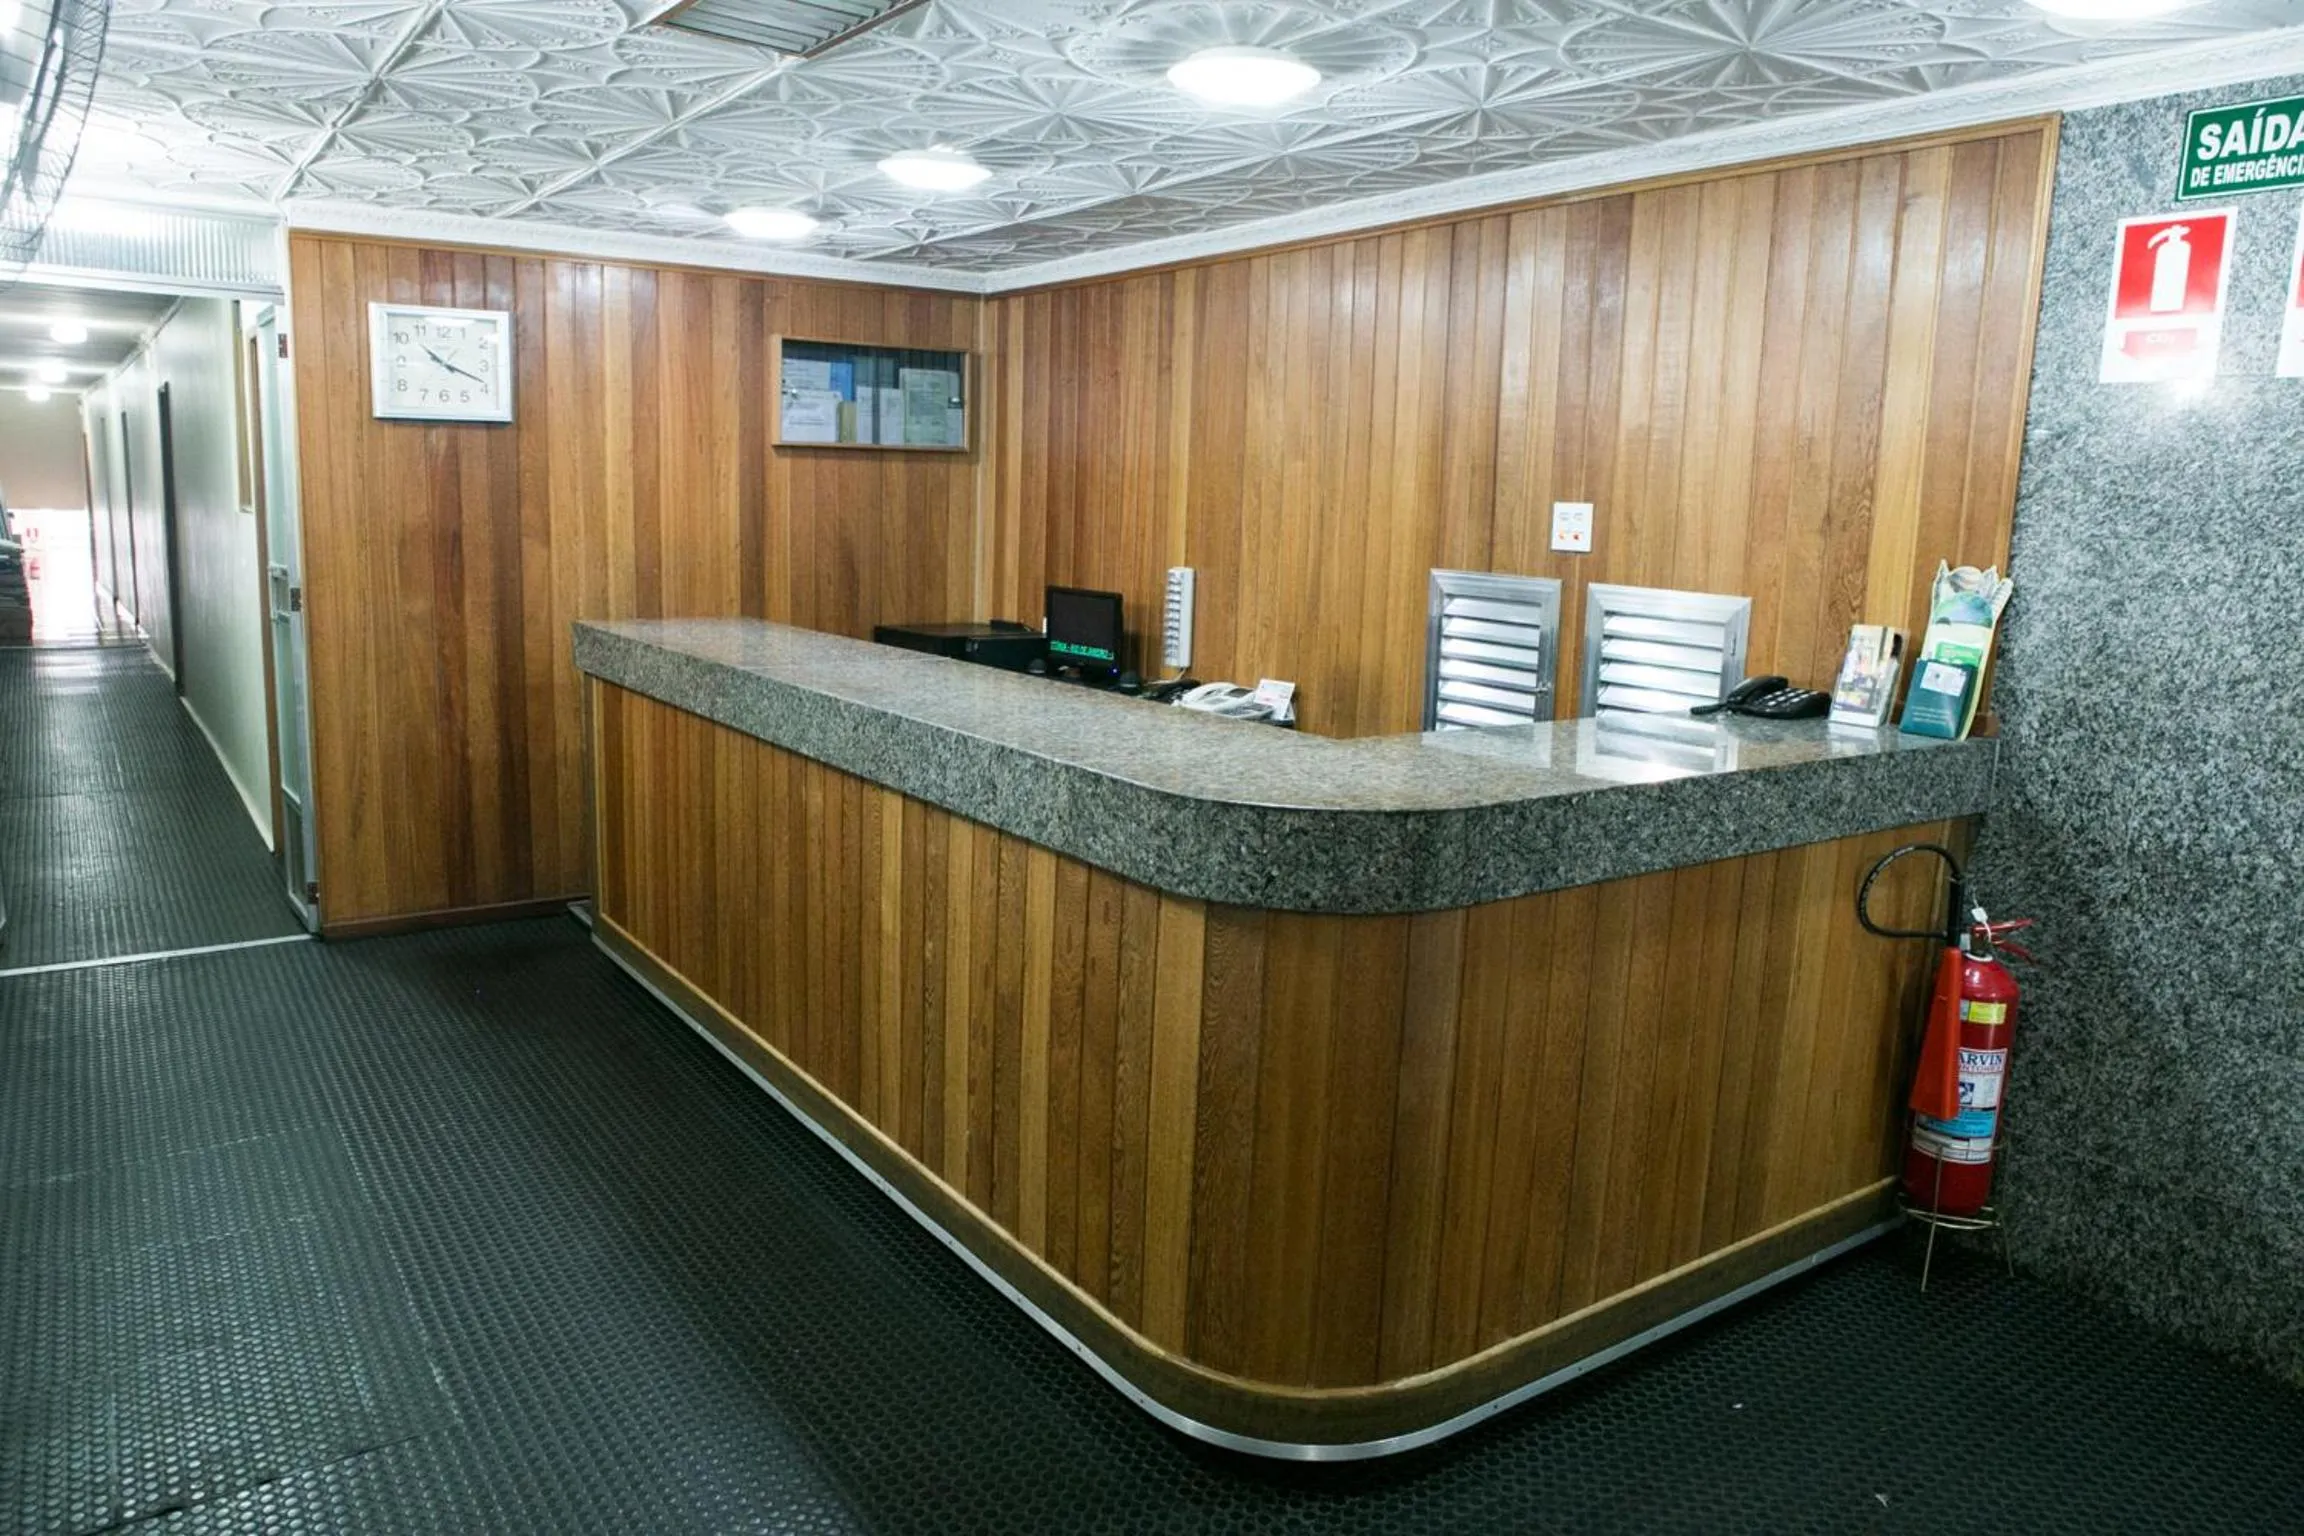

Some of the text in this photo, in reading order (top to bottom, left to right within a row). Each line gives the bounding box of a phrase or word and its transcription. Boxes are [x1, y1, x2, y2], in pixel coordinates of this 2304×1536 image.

[2197, 107, 2304, 160] SAÍDA
[2190, 153, 2304, 188] DE EMERGÊNCI
[414, 325, 427, 337] 11
[436, 326, 451, 339] 12
[460, 327, 466, 339] 1
[393, 332, 410, 345] 10
[478, 360, 489, 373] 3
[397, 378, 408, 392] 8
[419, 388, 429, 401] 7
[439, 389, 450, 403] 6
[460, 389, 470, 403] 5
